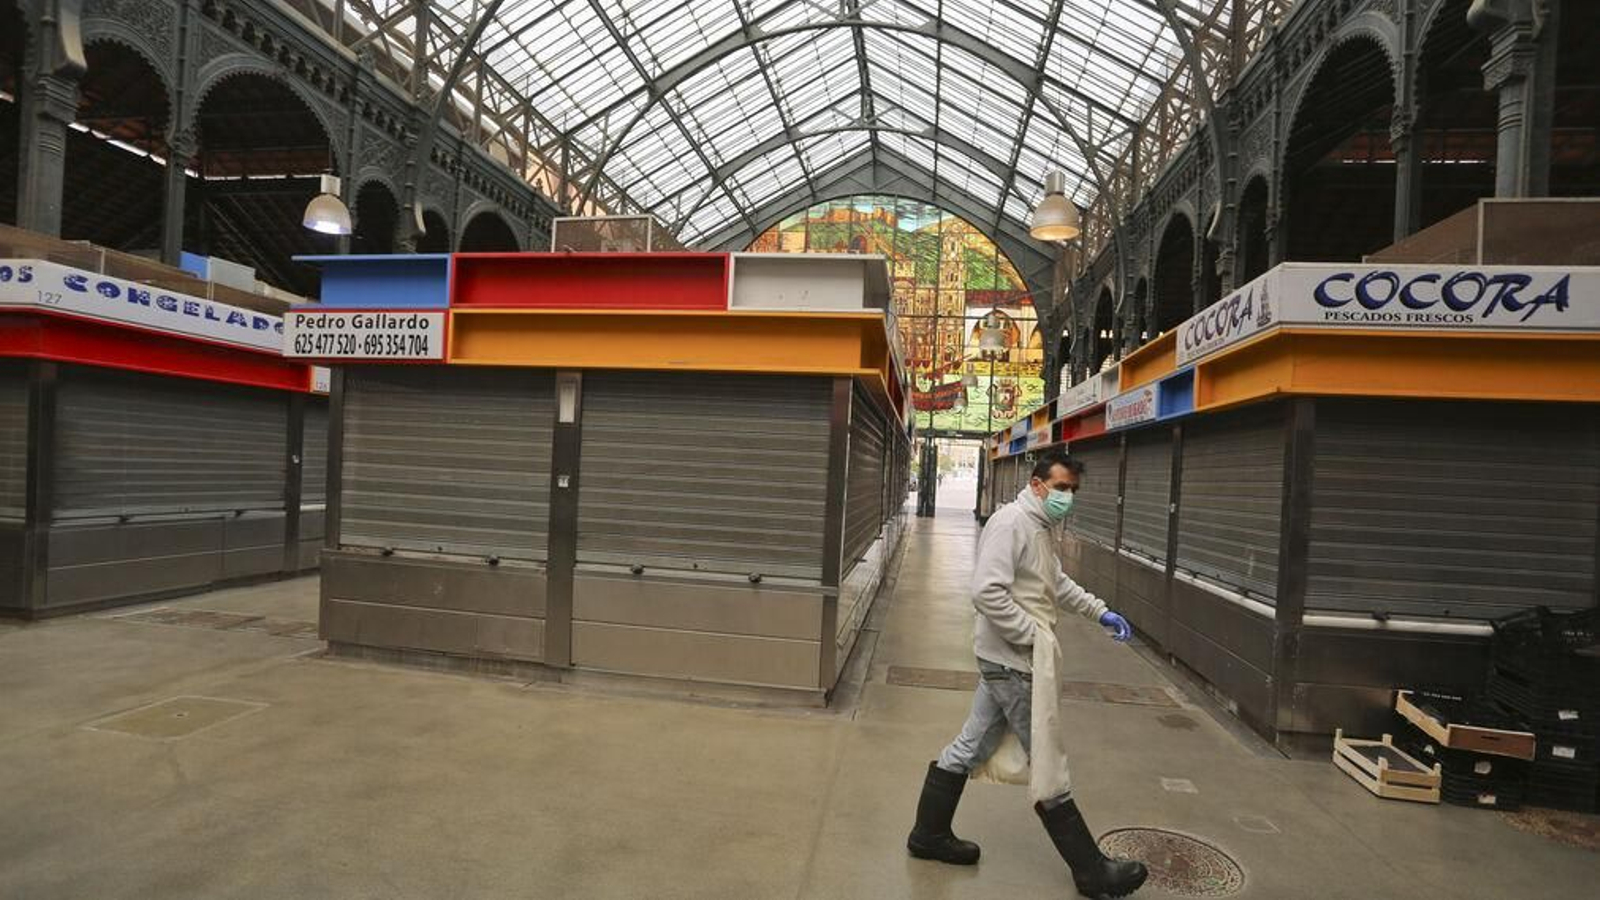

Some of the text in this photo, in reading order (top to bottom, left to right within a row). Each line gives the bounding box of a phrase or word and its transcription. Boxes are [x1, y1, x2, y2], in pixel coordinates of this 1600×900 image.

[38, 290, 62, 304] 127
[1313, 270, 1570, 322] COCORA
[295, 313, 429, 329] Pedro Gallardo
[1185, 285, 1254, 351] COCORA
[1325, 311, 1474, 324] PESCADOS FRESCOS
[295, 333, 428, 355] 625 477 520 695 354 704
